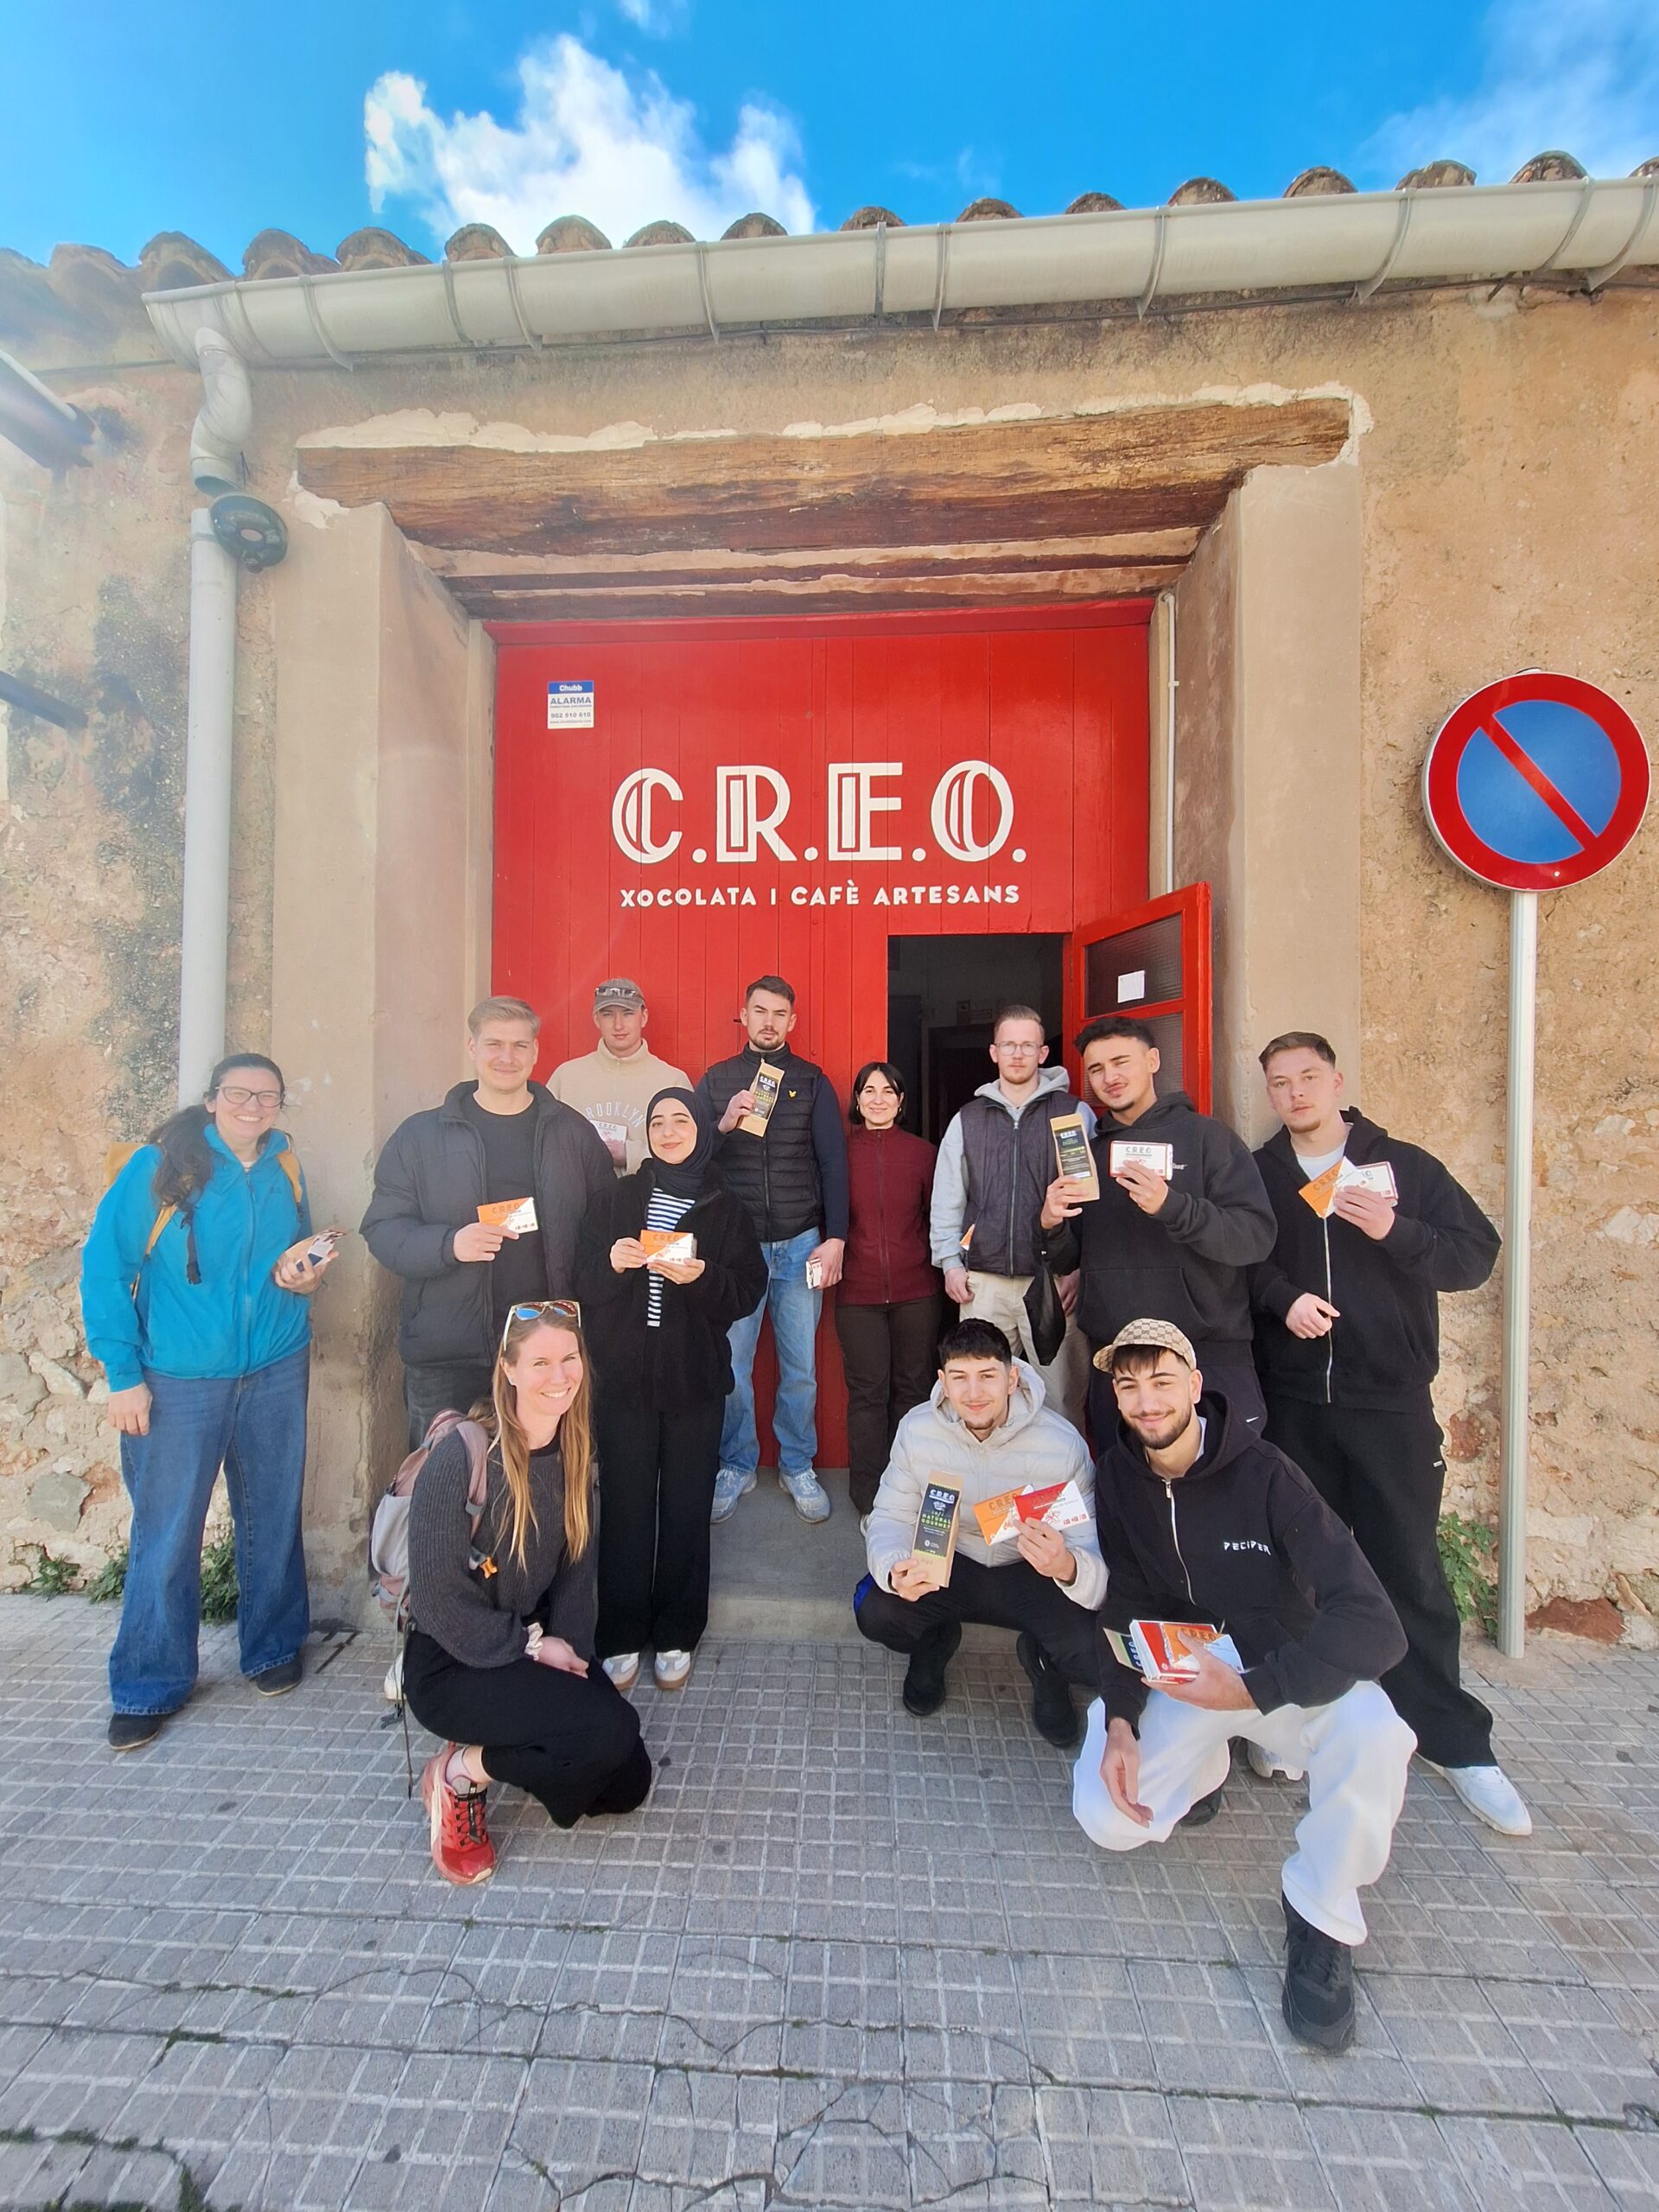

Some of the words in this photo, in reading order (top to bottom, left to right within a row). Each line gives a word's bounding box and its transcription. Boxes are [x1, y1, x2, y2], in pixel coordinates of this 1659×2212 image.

[612, 760, 1027, 863] C.R.E.O.
[620, 887, 757, 907] XOCOLATA
[771, 887, 777, 906] I
[791, 880, 860, 905] CAFÈ
[874, 885, 1020, 906] ARTESANS
[586, 1101, 646, 1128] ROOKLYN
[1313, 1169, 1338, 1191] CREO
[930, 1488, 956, 1501] CREO
[922, 1513, 951, 1524] NATURAL
